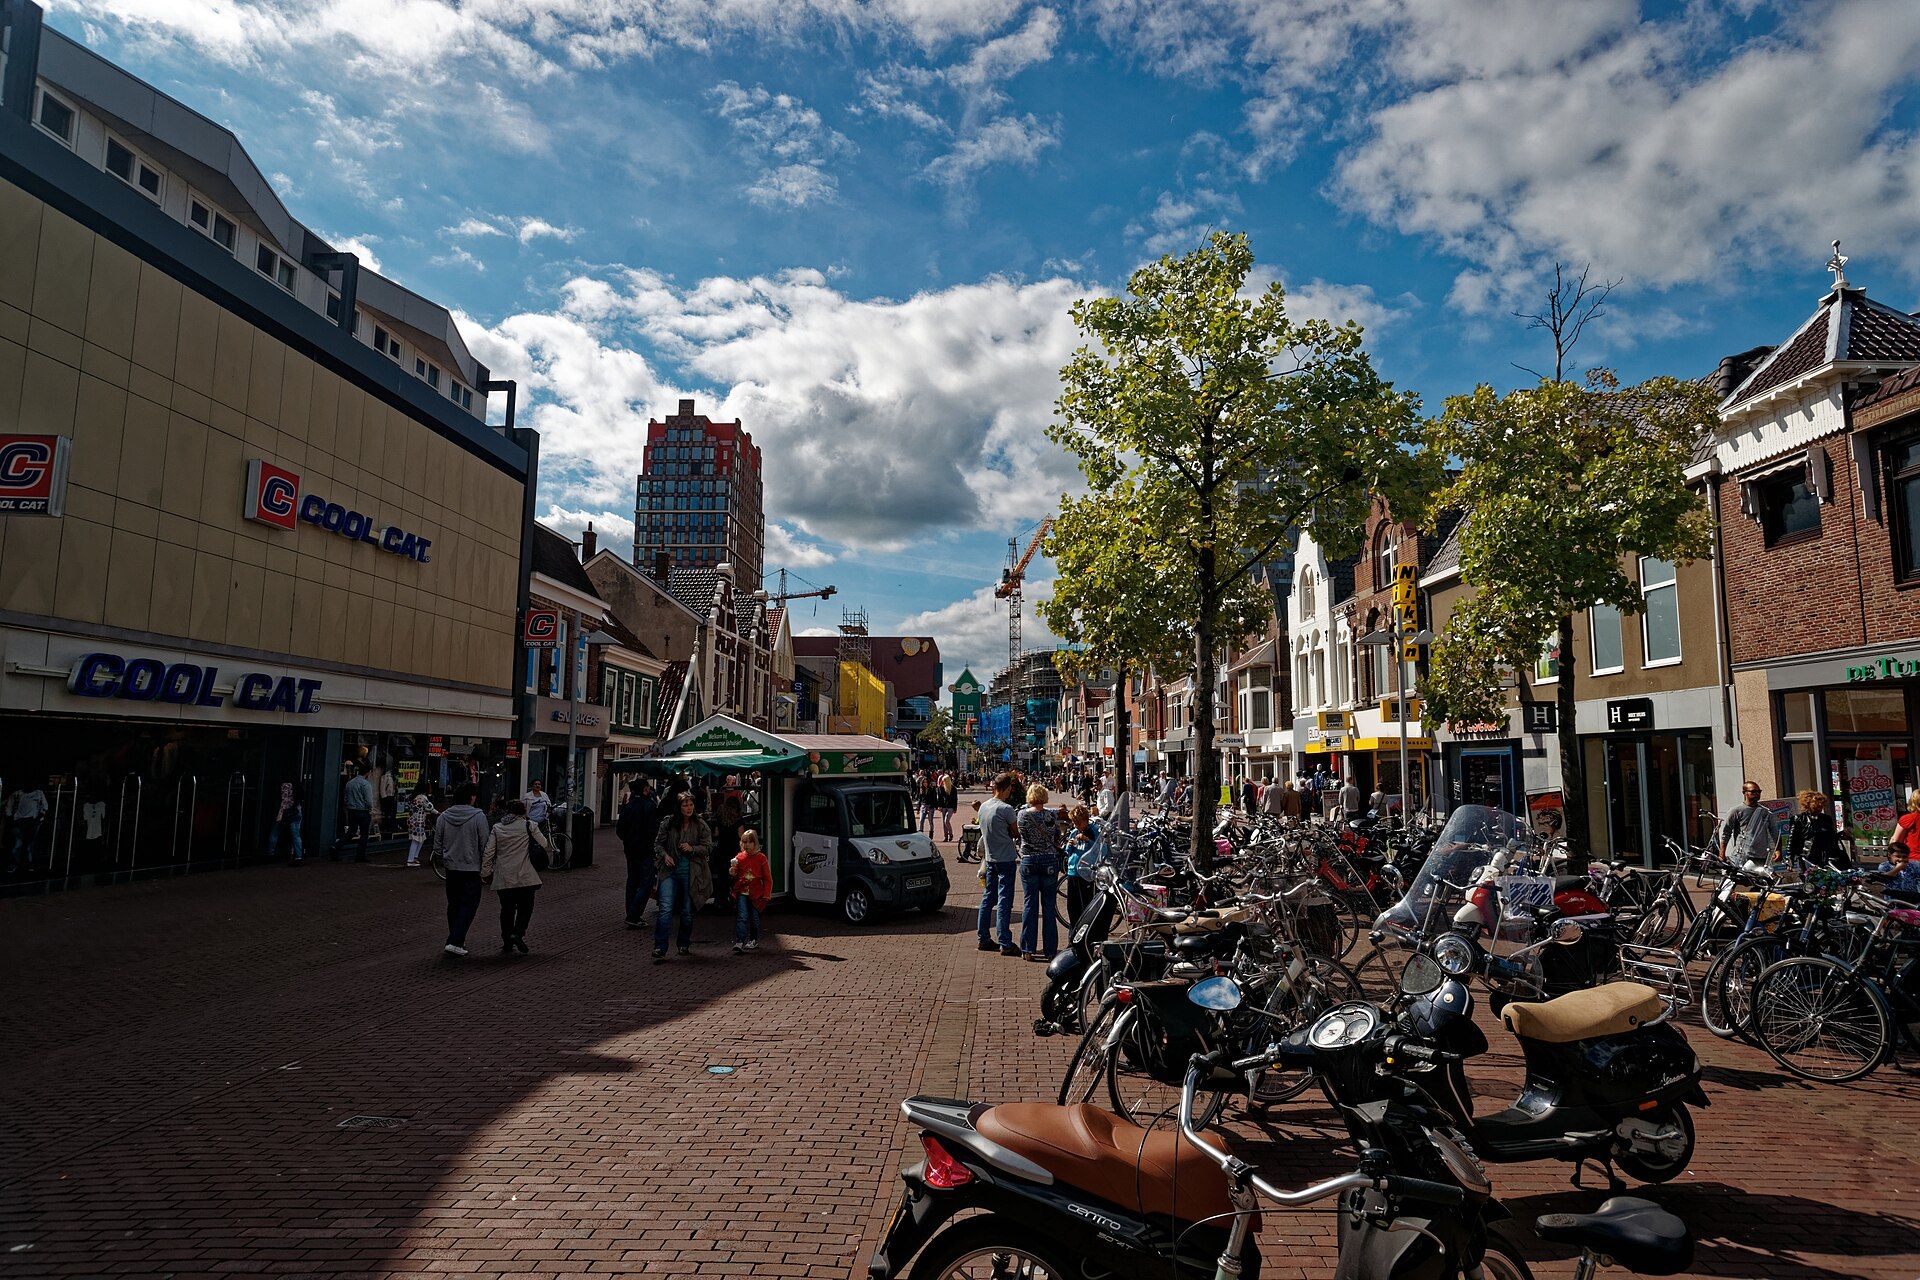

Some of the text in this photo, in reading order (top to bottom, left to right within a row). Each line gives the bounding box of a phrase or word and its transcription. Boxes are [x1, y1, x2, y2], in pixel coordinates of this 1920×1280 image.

[0, 500, 15, 509] OL
[261, 475, 432, 564] C COOL CAT
[67, 652, 224, 707] COOL
[558, 711, 600, 726] SNAKERS
[1851, 790, 1889, 803] GROOT
